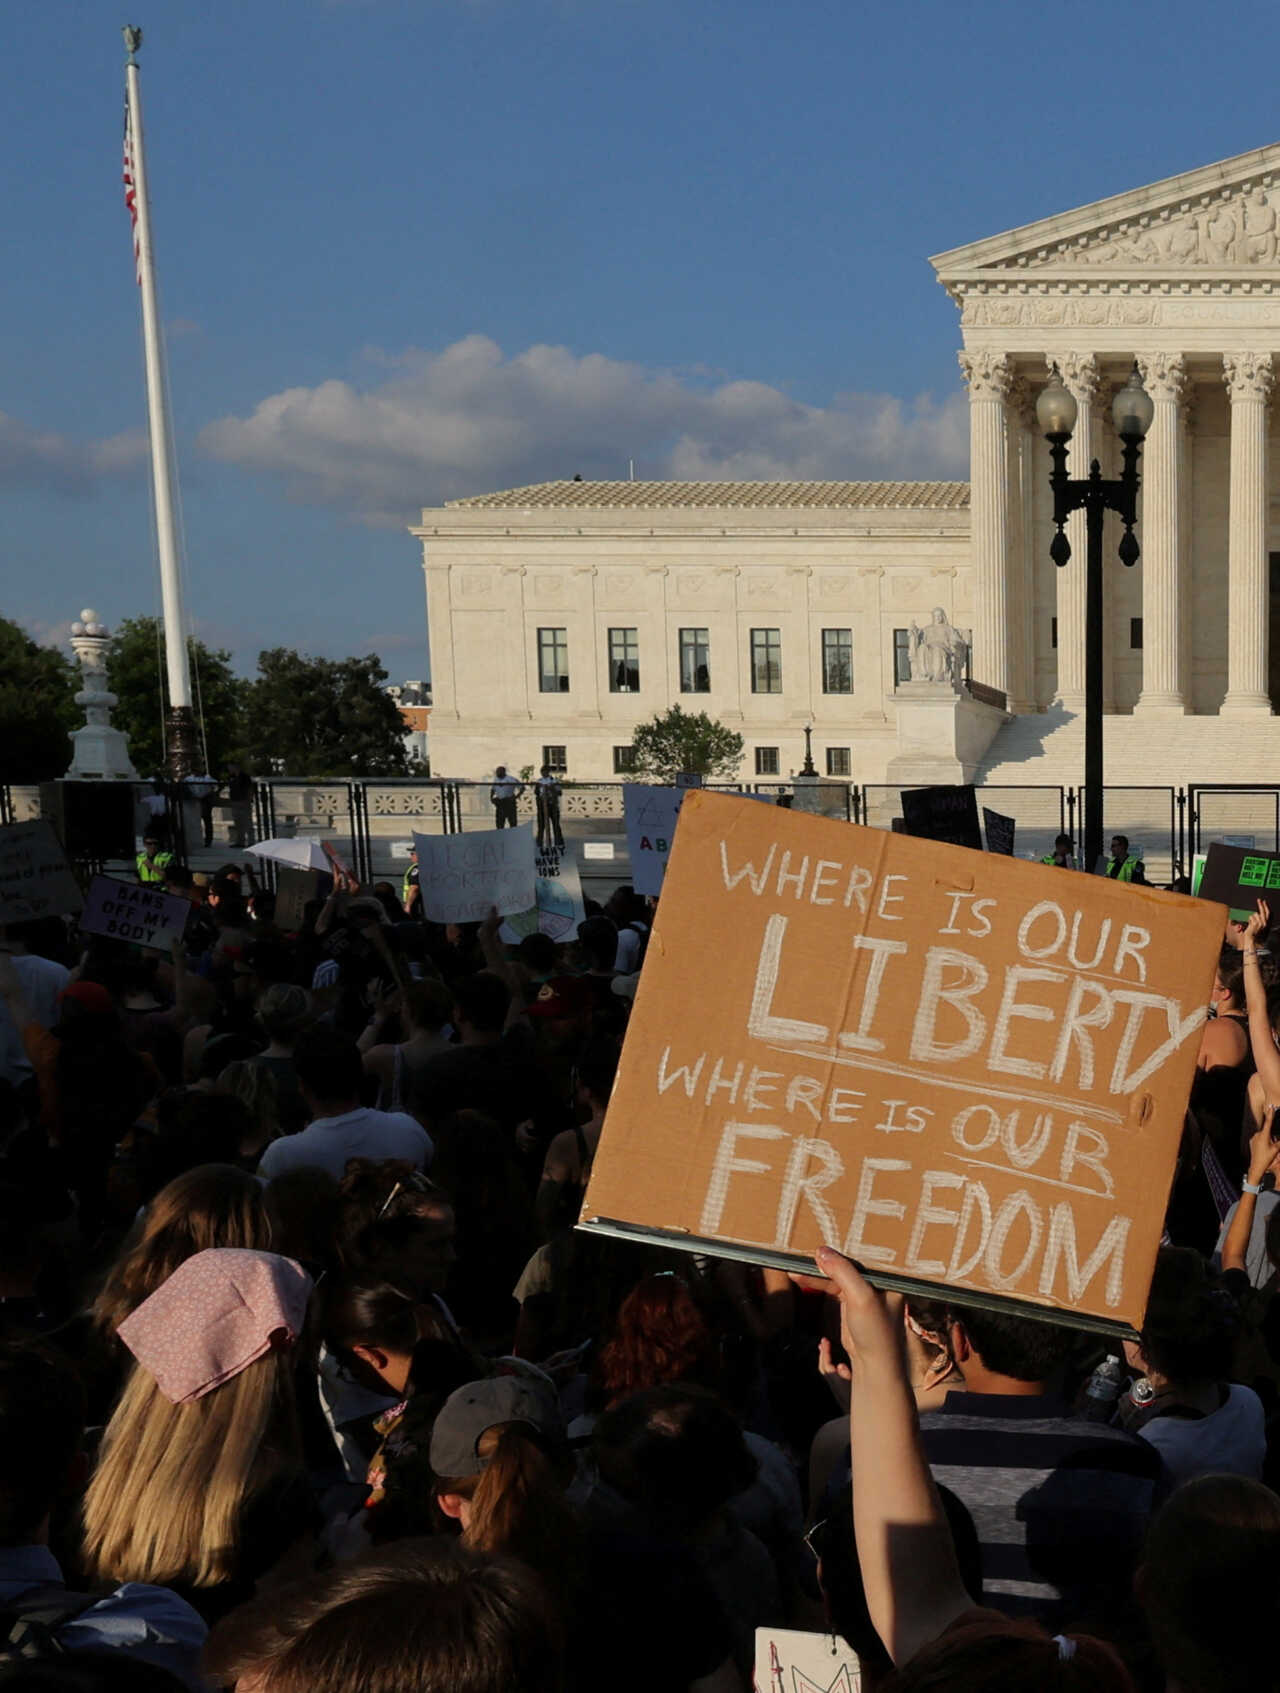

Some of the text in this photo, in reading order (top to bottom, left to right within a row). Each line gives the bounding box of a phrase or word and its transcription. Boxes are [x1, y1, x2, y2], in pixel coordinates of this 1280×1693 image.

[540, 846, 566, 857] WHY
[102, 901, 169, 928] OFF MY
[107, 919, 156, 942] BODY
[118, 886, 165, 909] BANS
[719, 839, 1152, 983] WHERE IS OUR
[747, 914, 1208, 1096] LIBERTY
[656, 1046, 867, 1125] WHERE
[879, 1098, 934, 1136] IS
[951, 1104, 1112, 1197] OUR
[699, 1120, 1131, 1308] FREEDOM
